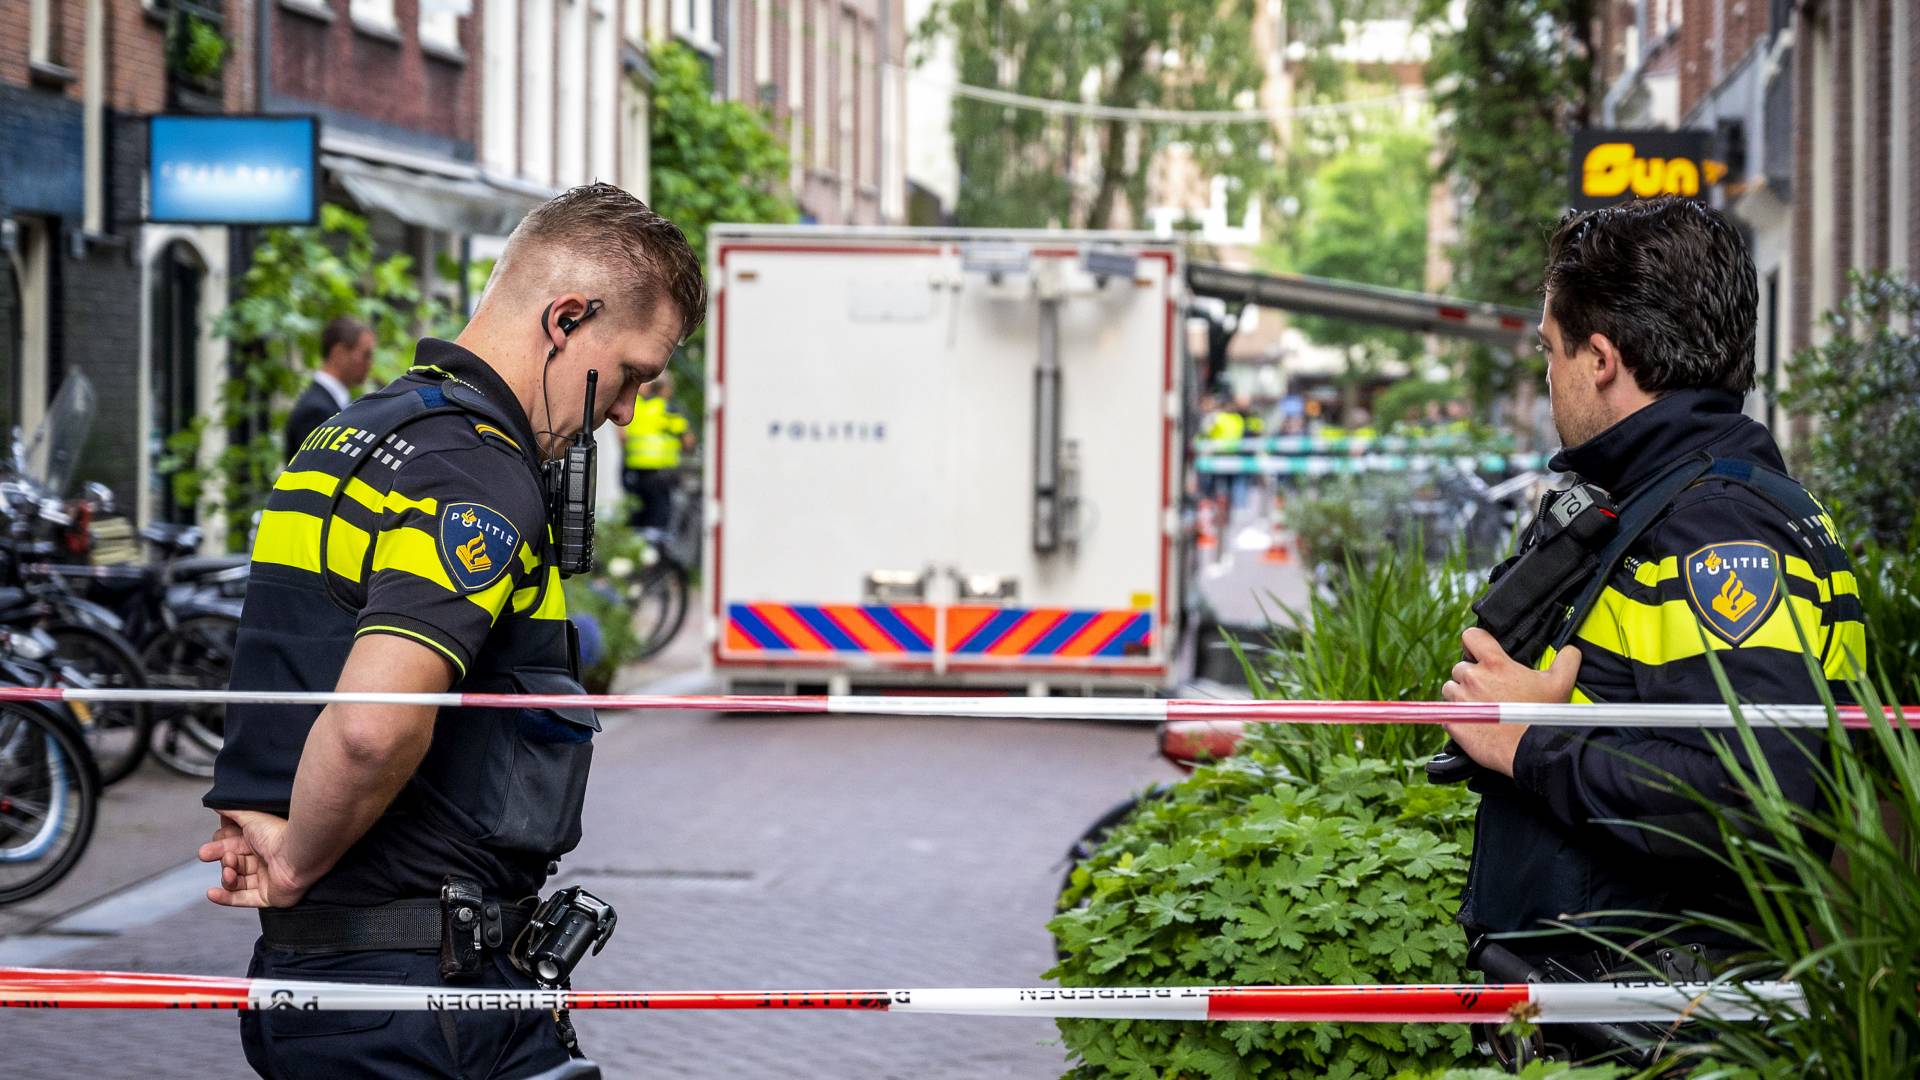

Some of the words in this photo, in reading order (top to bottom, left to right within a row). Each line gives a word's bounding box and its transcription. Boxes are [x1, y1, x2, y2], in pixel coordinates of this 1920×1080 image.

[1583, 143, 1699, 197] Sun
[1561, 493, 1582, 518] TQ
[1695, 557, 1770, 575] POLITIE
